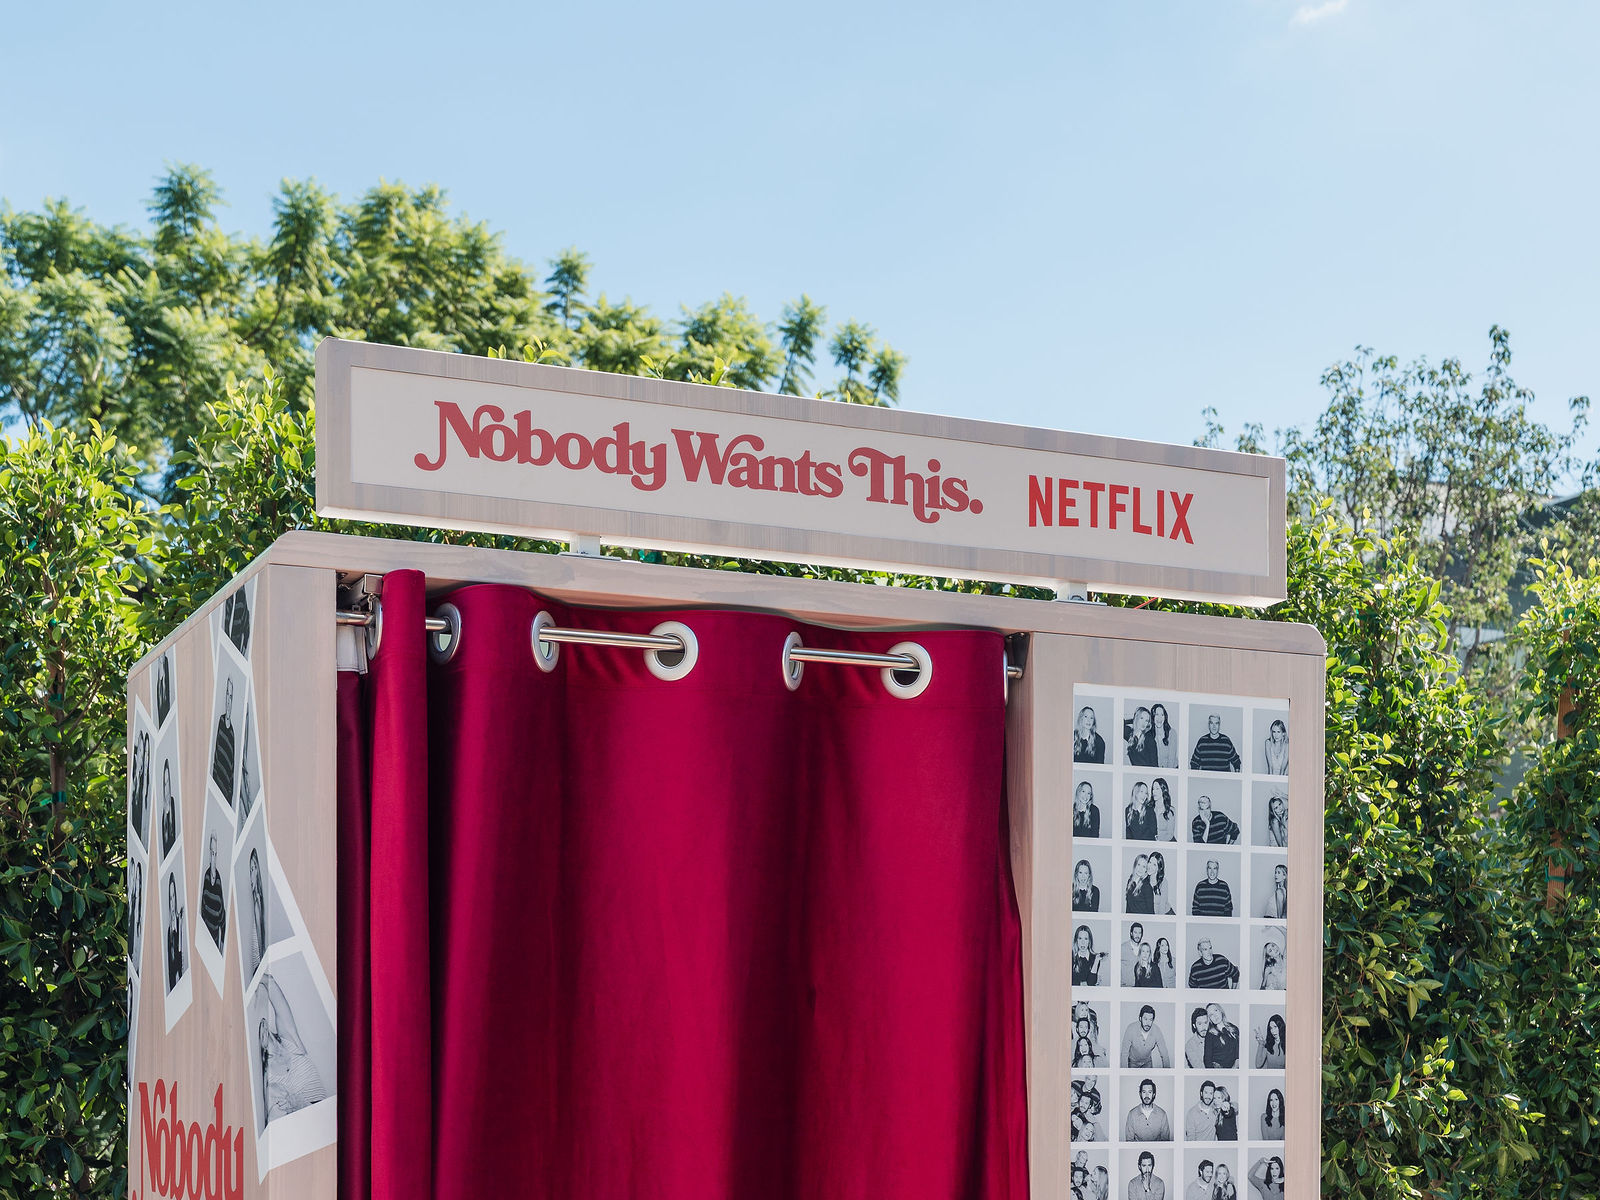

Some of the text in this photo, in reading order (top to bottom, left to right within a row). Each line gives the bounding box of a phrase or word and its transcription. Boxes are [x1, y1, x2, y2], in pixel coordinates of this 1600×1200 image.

[415, 401, 983, 524] Nobody Wants This.
[1028, 474, 1194, 545] NETFLIX
